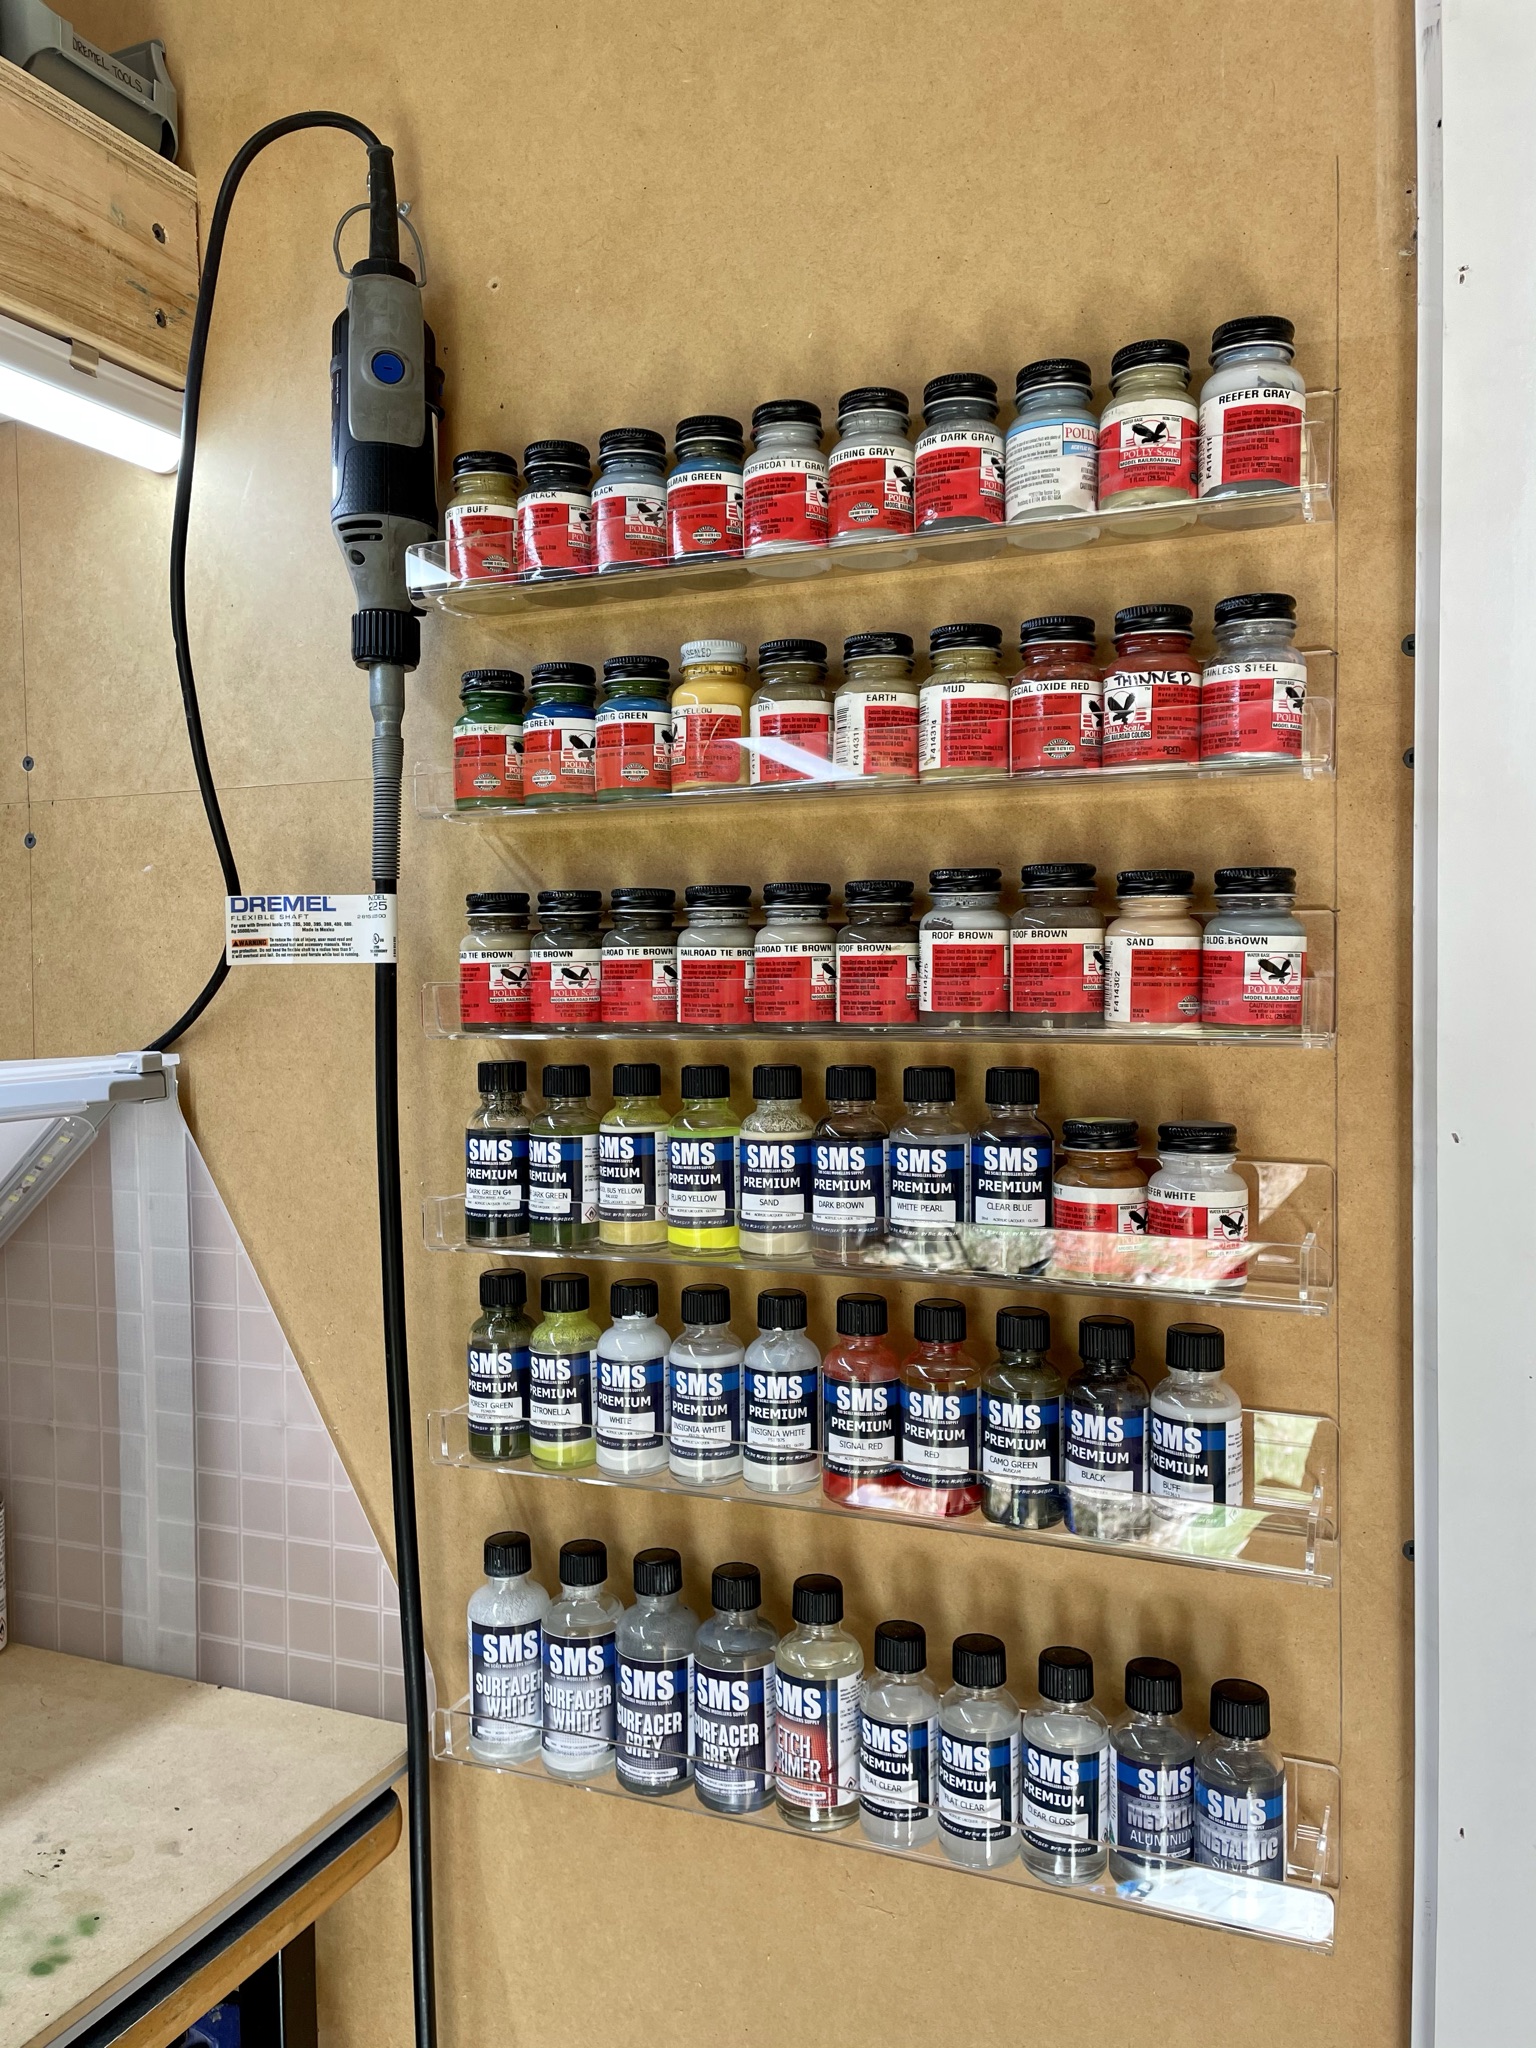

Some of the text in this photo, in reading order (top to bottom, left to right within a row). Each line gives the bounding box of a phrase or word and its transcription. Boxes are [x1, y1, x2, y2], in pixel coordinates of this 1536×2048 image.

[73, 37, 143, 93] DREMEL TOOLS
[1219, 389, 1290, 404] REEFER GRAY
[919, 432, 996, 450] LARK DARK GRAY
[869, 448, 896, 456] GRAY
[1123, 448, 1178, 460] POLLY Scale
[804, 460, 826, 472] GRAY
[691, 473, 722, 482] GREEN
[531, 491, 557, 500] BLACK
[594, 486, 614, 498] BLACK
[467, 505, 489, 514] BUFF
[629, 526, 654, 534] POLLY
[1244, 664, 1279, 673] STEEL
[1114, 672, 1192, 686] THINNED
[942, 684, 965, 694] MUD
[1036, 682, 1090, 692] OXIDE RED
[866, 693, 897, 702] EARTH
[758, 704, 774, 712] DIRT
[530, 718, 555, 727] GREEN
[1123, 724, 1145, 732] Scale
[230, 896, 336, 913] DREMEL
[368, 901, 388, 912] 225
[932, 930, 994, 940] ROOF BROWN
[1012, 930, 1068, 939] ROOF BROWN
[784, 944, 832, 953] TIE BROWN
[838, 944, 892, 952] ROOF BROWN
[1126, 938, 1154, 946] SAND
[642, 948, 674, 956] BROWN
[680, 948, 734, 956] RAILROAD TIE
[1248, 986, 1280, 994] POLLY
[469, 1138, 512, 1162] SMS
[530, 1139, 562, 1164] SMS
[600, 1136, 634, 1160] SMS
[672, 1142, 716, 1166] SMS
[748, 1144, 796, 1169] SMS
[817, 1146, 866, 1171] SMS
[896, 1148, 947, 1174] SMS
[984, 1146, 1038, 1173] SMS
[466, 1168, 518, 1180] PREMIUM
[669, 1172, 721, 1185] PREMIUM
[744, 1176, 800, 1189] PREMIUM
[814, 1178, 871, 1191] PREMIUM
[892, 1180, 952, 1194] PREMIUM
[978, 1179, 1042, 1193] PREMIUM
[468, 1188, 481, 1196] DARK
[482, 1188, 502, 1196] GREEN
[546, 1192, 568, 1200] GREEN
[618, 1187, 643, 1195] YELLOW
[688, 1194, 718, 1202] YELLOW
[1164, 1191, 1196, 1202] WHITE
[759, 1198, 780, 1206] SAND
[818, 1200, 864, 1209] DARK BROWN
[897, 1202, 944, 1212] WHITE PEARL
[987, 1202, 1032, 1212] CLEAR BLUE
[470, 1350, 512, 1375] SMS
[530, 1356, 571, 1382] SMS
[601, 1363, 646, 1388] SMS
[468, 1380, 518, 1393] PREMIUM
[676, 1370, 723, 1396] SMS
[754, 1374, 803, 1400] SMS
[530, 1385, 577, 1398] PREMIUM
[490, 1402, 514, 1410] GREEN
[598, 1392, 651, 1407] PREMIUM
[836, 1386, 888, 1412] SMS
[909, 1391, 961, 1420] SMS
[532, 1405, 570, 1416] CITRONELLA
[672, 1402, 728, 1416] PREMIUM
[750, 1404, 808, 1420] PREMIUM
[988, 1399, 1041, 1430] SMS
[610, 1416, 632, 1425] WHITE
[832, 1417, 892, 1432] PREMIUM
[1071, 1409, 1124, 1442] SMS
[674, 1422, 726, 1434] INSIGNIA WHITE
[751, 1428, 806, 1437] INSIGNIA WHITE
[904, 1422, 966, 1440] PREMIUM
[984, 1430, 1046, 1450] PREMIUM
[1152, 1417, 1202, 1454] SMS
[840, 1440, 866, 1450] SIGNAL
[924, 1450, 940, 1459] RED
[1066, 1442, 1130, 1464] PREMIUM
[990, 1455, 1038, 1469] CAMO GREEN
[1150, 1450, 1208, 1477] PREMIUM
[1081, 1470, 1106, 1482] BLACK
[1162, 1480, 1181, 1492] BUFF
[482, 1630, 538, 1664] SMS
[550, 1643, 604, 1677] SMS
[620, 1664, 674, 1700] SMS
[544, 1682, 612, 1710] SURFACER
[696, 1672, 750, 1712] SMS
[776, 1674, 822, 1720] SMS
[486, 1692, 535, 1718] WHITE
[552, 1708, 600, 1733] WHITE
[616, 1702, 682, 1736] SURFACER
[778, 1726, 811, 1760] ETCH
[862, 1718, 908, 1754] SMS
[624, 1730, 664, 1759] GREY
[702, 1742, 740, 1770] GREY
[860, 1747, 914, 1775] PREMIUM
[942, 1736, 991, 1772] SMS
[1027, 1748, 1080, 1786] SMS
[940, 1766, 997, 1793] PREMIUM
[1138, 1766, 1192, 1796] SMS
[882, 1782, 903, 1794] CLEAR
[1024, 1777, 1085, 1808] PREMIUM
[960, 1801, 986, 1812] CLEAR
[1208, 1788, 1266, 1826] SMS
[1027, 1804, 1076, 1827] CLEAR GLOSS
[1128, 1804, 1194, 1832] METALLI
[1200, 1829, 1278, 1863] METALLIC
